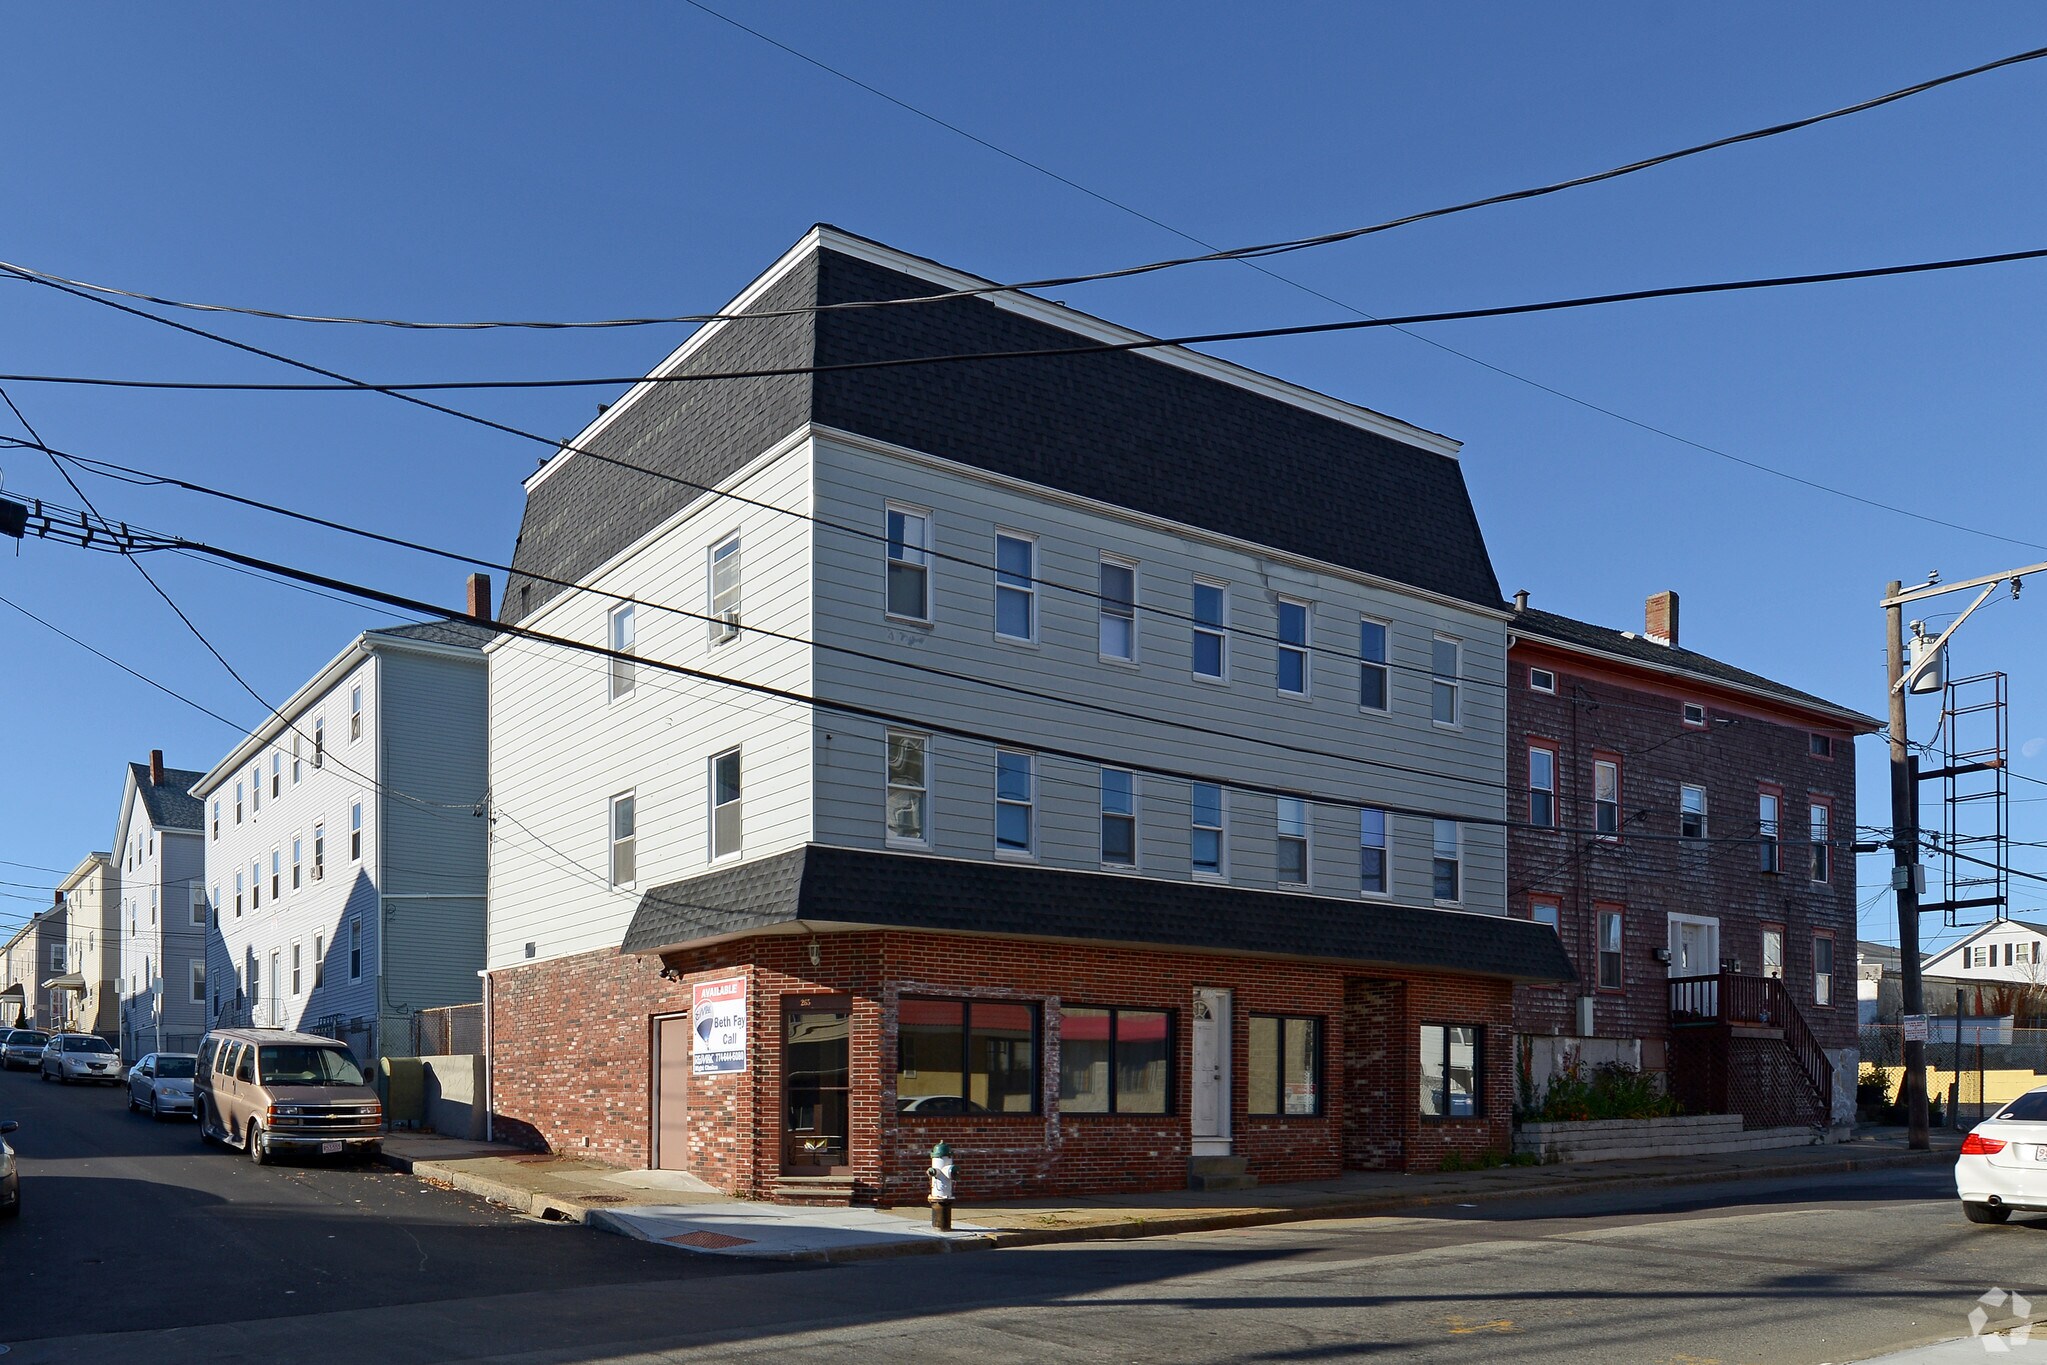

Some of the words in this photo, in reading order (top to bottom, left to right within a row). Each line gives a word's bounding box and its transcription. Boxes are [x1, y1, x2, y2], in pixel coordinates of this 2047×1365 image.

[702, 984, 737, 998] AVAILABLE
[714, 1016, 731, 1028] Beth
[733, 1015, 745, 1028] Fay
[723, 1033, 737, 1044] Call
